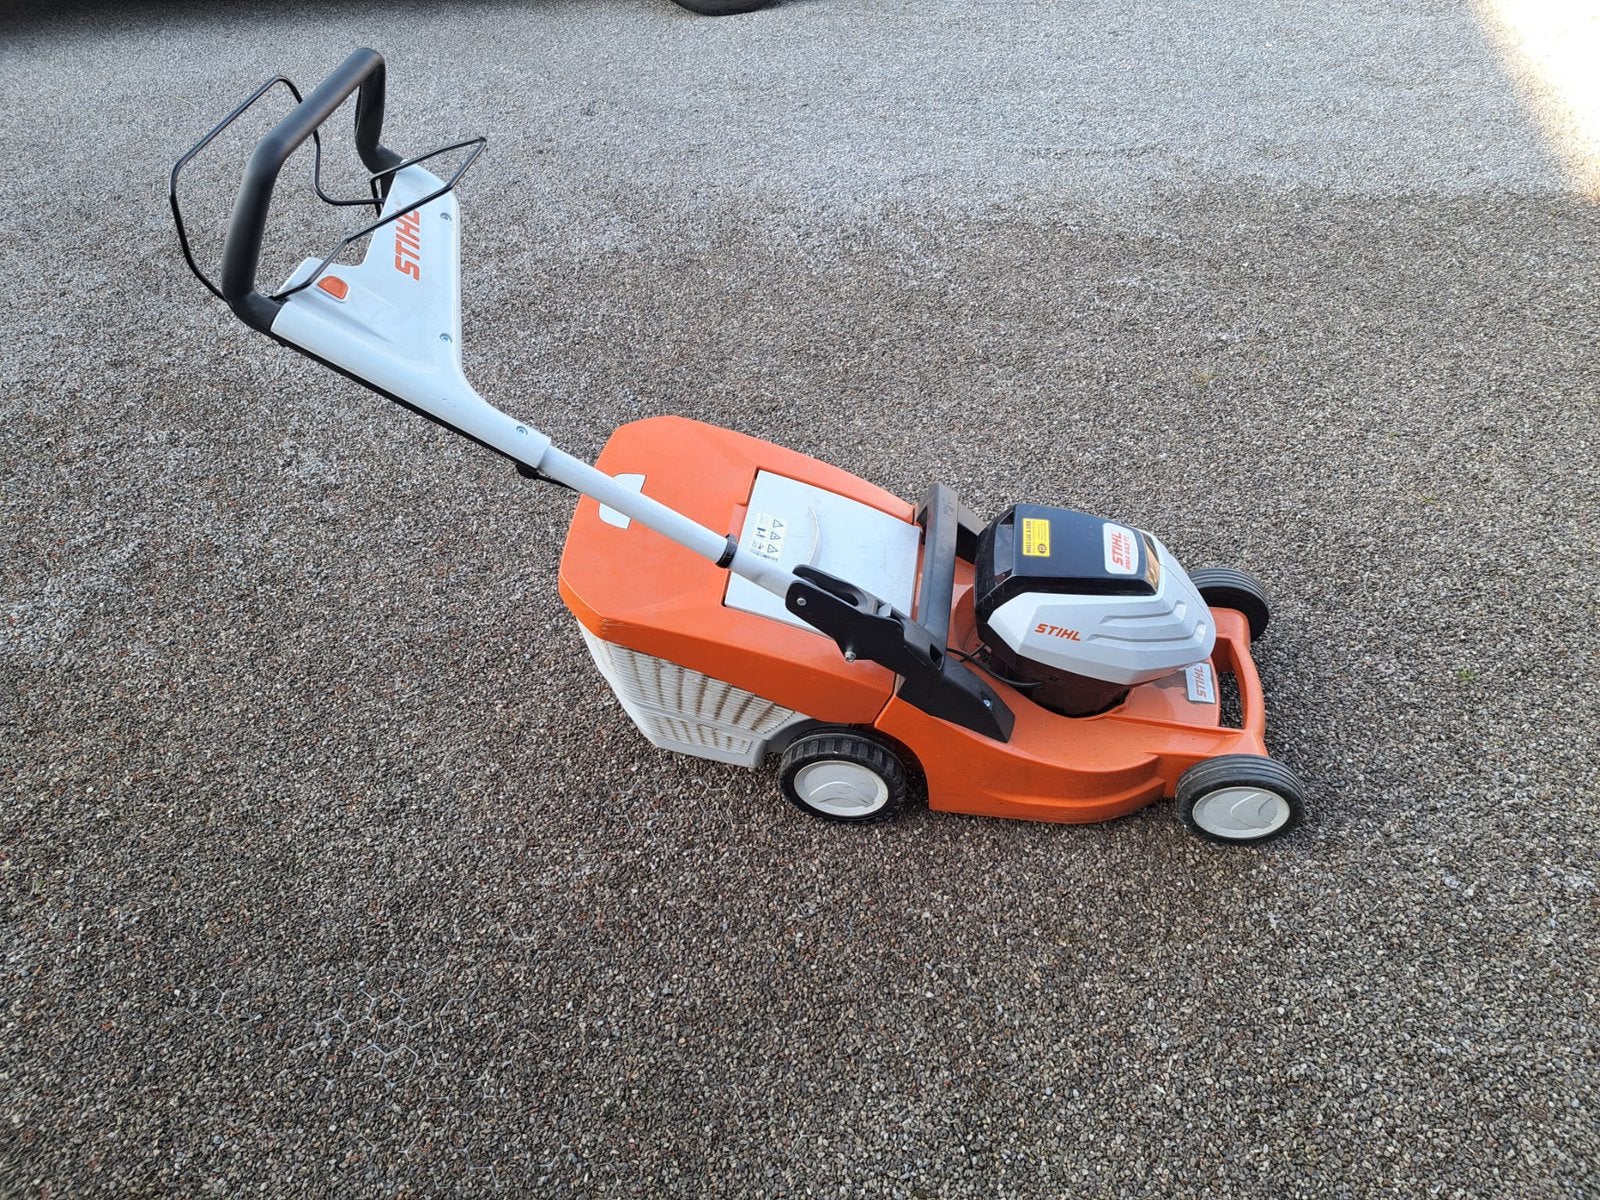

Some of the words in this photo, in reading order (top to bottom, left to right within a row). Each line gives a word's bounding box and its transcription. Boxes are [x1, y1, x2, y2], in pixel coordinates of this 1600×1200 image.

[1111, 532, 1123, 567] STIHL
[1035, 623, 1081, 641] STIHL
[1194, 666, 1207, 698] STIHL
